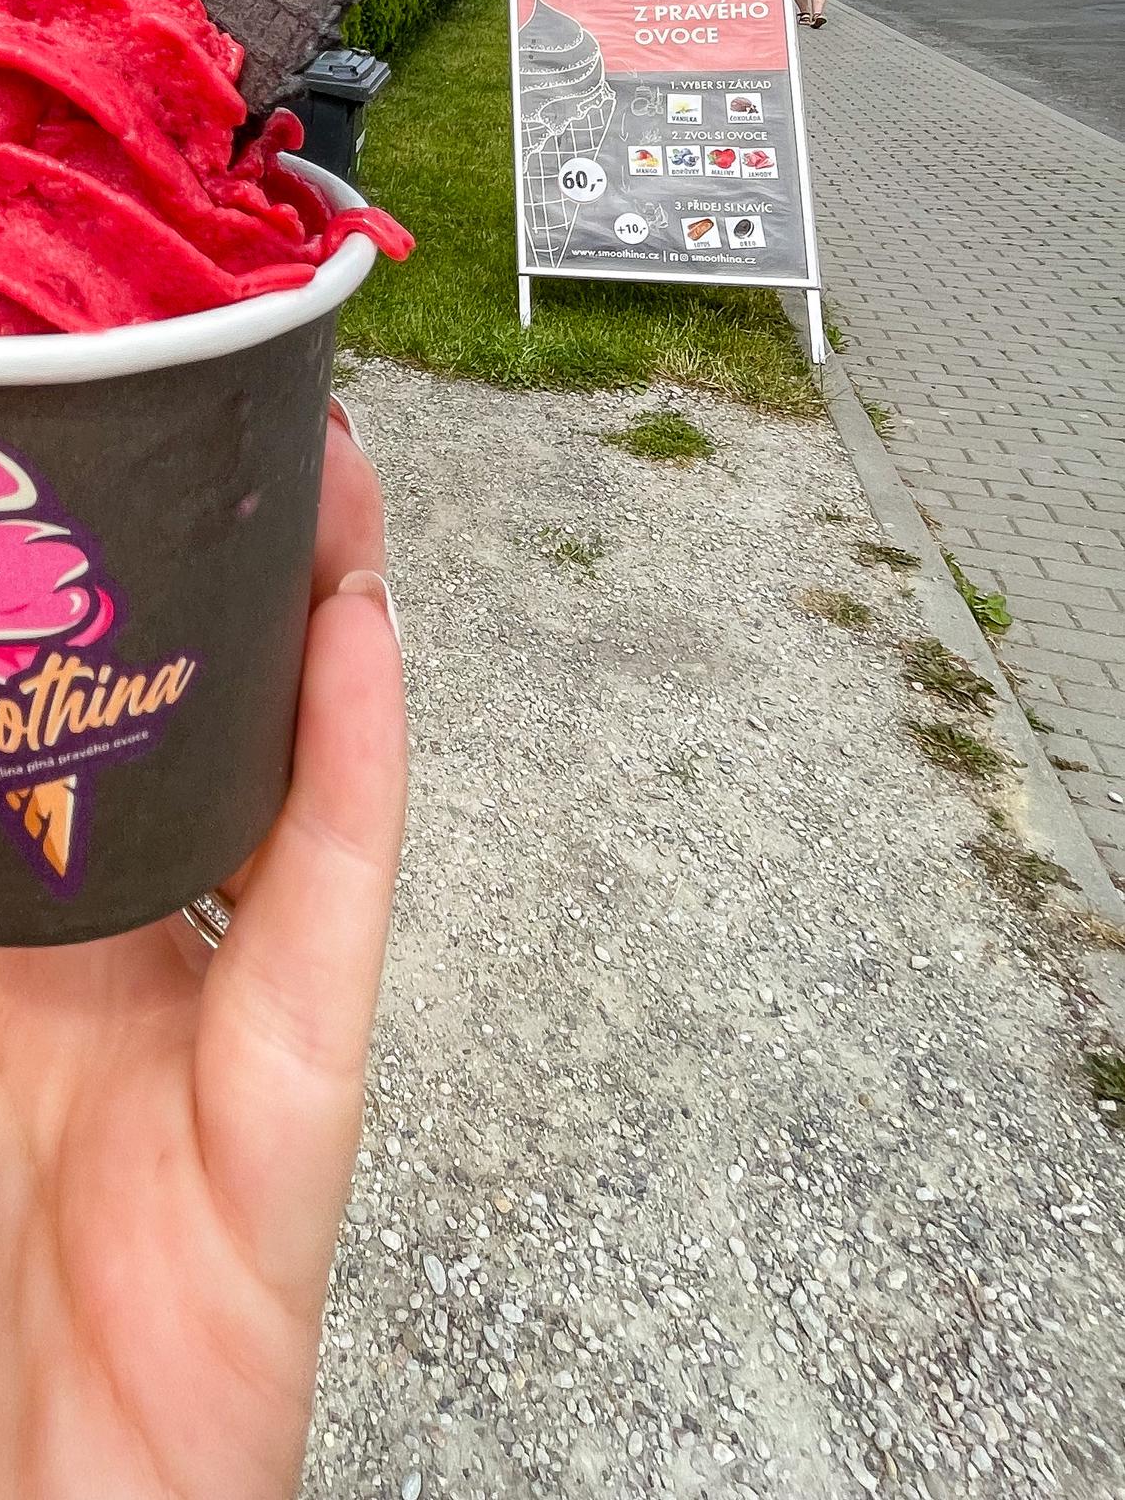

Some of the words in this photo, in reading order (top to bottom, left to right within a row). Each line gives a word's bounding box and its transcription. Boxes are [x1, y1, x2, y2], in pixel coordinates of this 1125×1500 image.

[634, 5, 648, 22] Z
[654, 0, 769, 22] PRAVÉHO
[634, 26, 719, 46] OVOCE
[671, 81, 678, 90] 1.
[680, 81, 713, 90] VYBER
[716, 81, 726, 90] SI
[728, 79, 771, 90] ZÁKLAD
[672, 132, 682, 141] 2.
[684, 131, 713, 141] ZVOL
[715, 131, 725, 141] SI
[726, 131, 768, 141] OVOCE
[562, 170, 604, 192] 60,-
[674, 201, 685, 211] 3.
[687, 200, 722, 212] PŘIDEJ
[723, 203, 733, 212] SI
[735, 201, 773, 213] NAVÍC
[616, 223, 647, 236] +10,-
[571, 249, 660, 261] www.smoothina.cz
[691, 253, 757, 265] smoothina.cz
[26, 756, 55, 777] plná
[113, 729, 150, 749] ovoce
